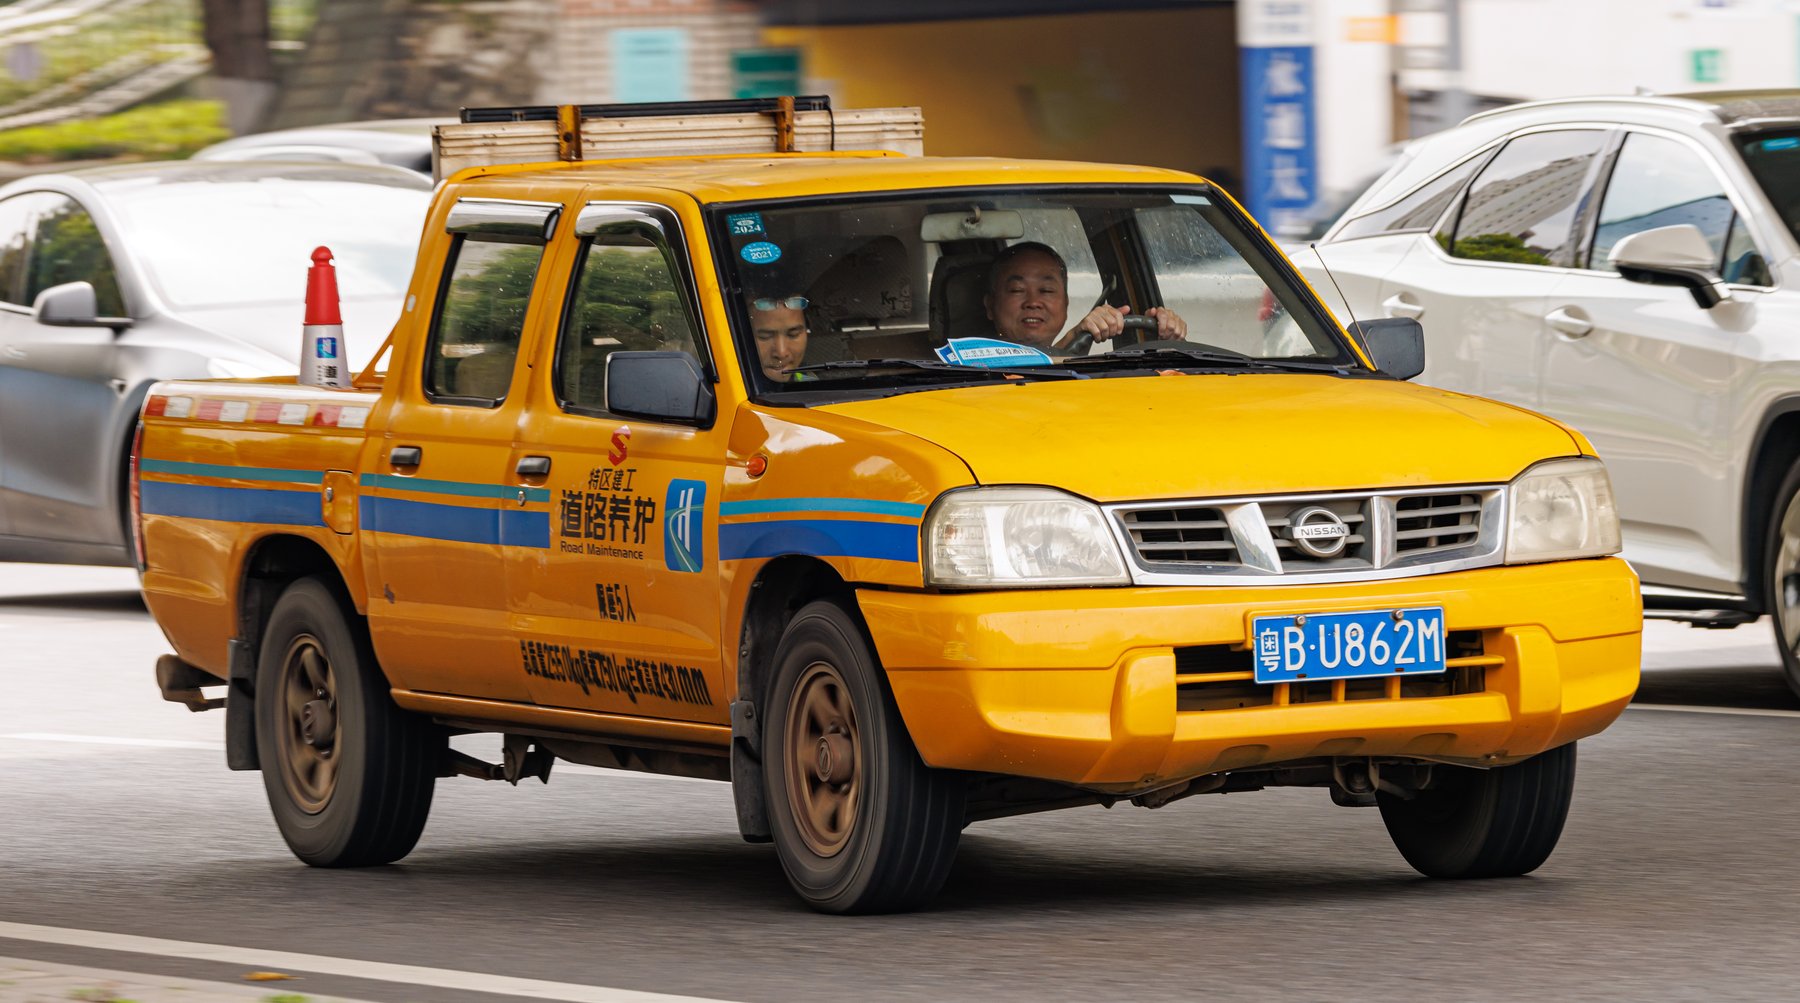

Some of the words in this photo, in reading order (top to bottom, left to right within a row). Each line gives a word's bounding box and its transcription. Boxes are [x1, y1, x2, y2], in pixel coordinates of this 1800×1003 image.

[734, 224, 762, 234] 2024
[750, 250, 773, 260] 2021
[588, 468, 637, 492] 特区建工
[560, 489, 656, 544] 道路养护
[1301, 526, 1345, 537] NISSAN
[560, 540, 583, 554] Road
[586, 543, 644, 560] Maintenance
